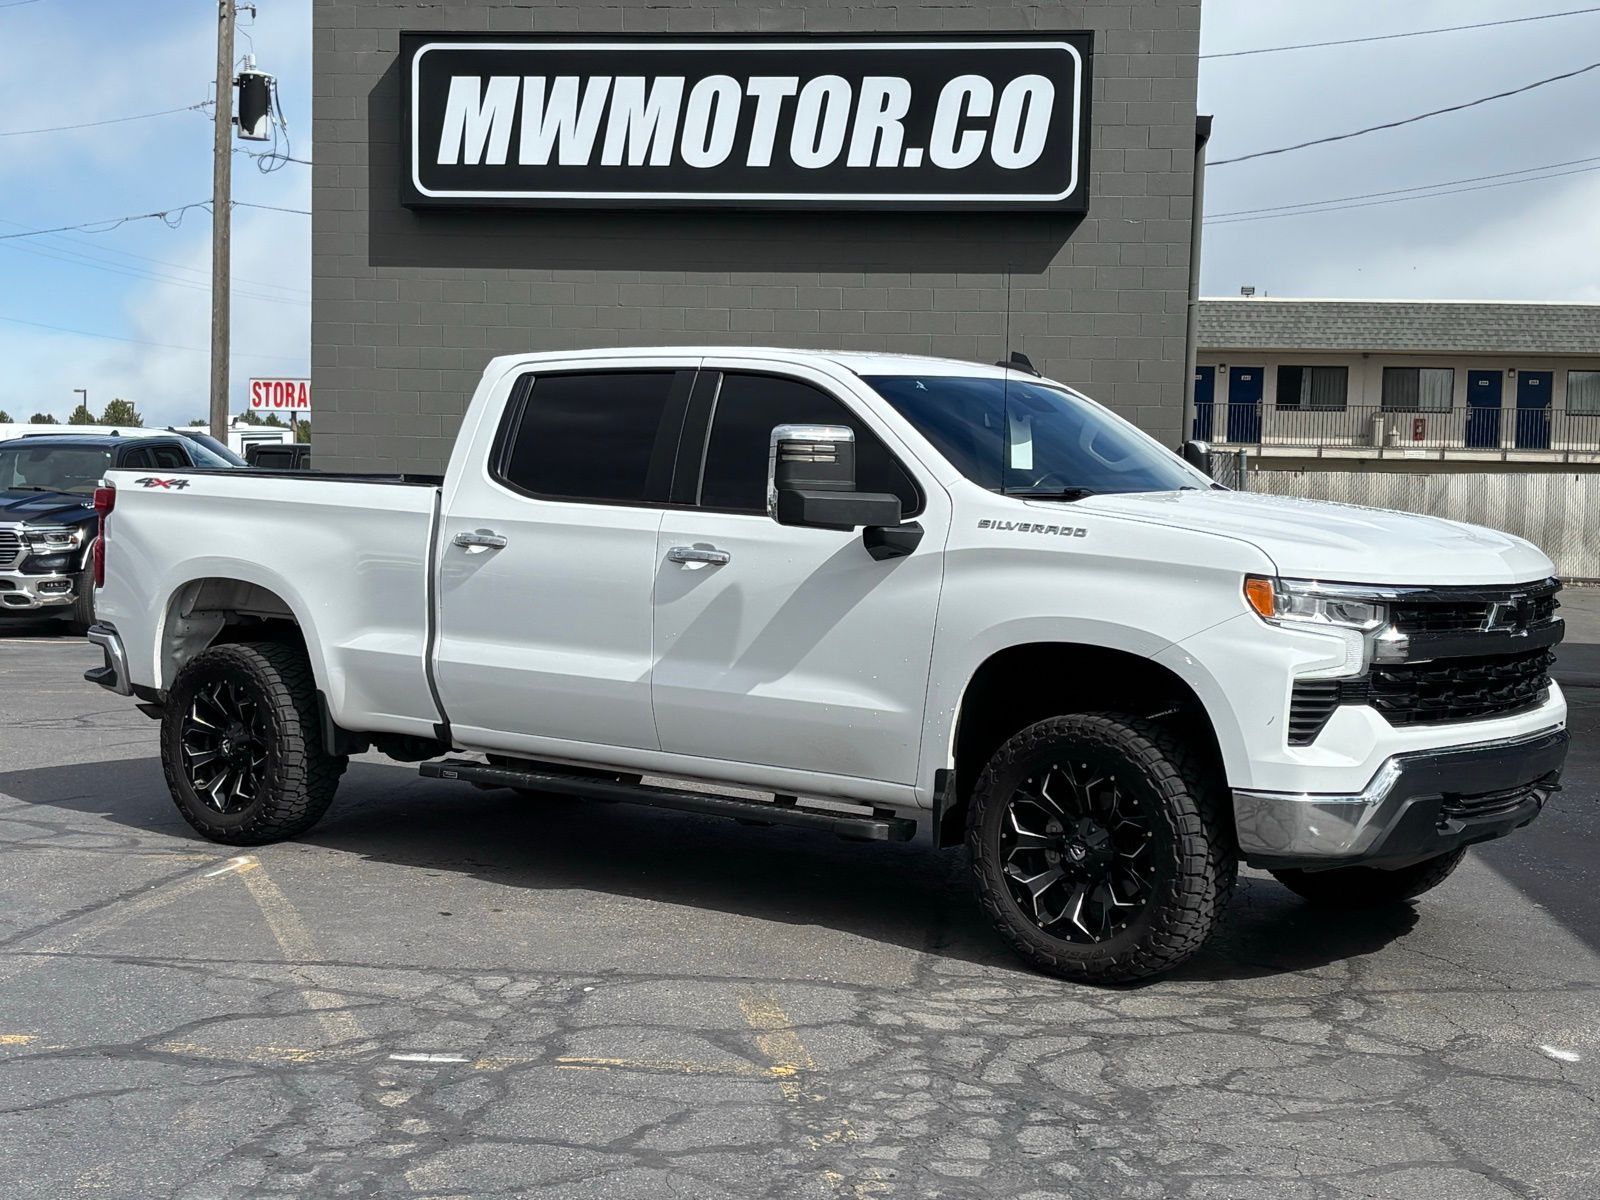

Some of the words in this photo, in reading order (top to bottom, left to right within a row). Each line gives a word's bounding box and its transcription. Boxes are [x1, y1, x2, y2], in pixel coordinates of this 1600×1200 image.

[437, 74, 1055, 169] MWMOTOR.CO
[252, 381, 311, 408] STORA
[977, 519, 1088, 538] SILVERADO
